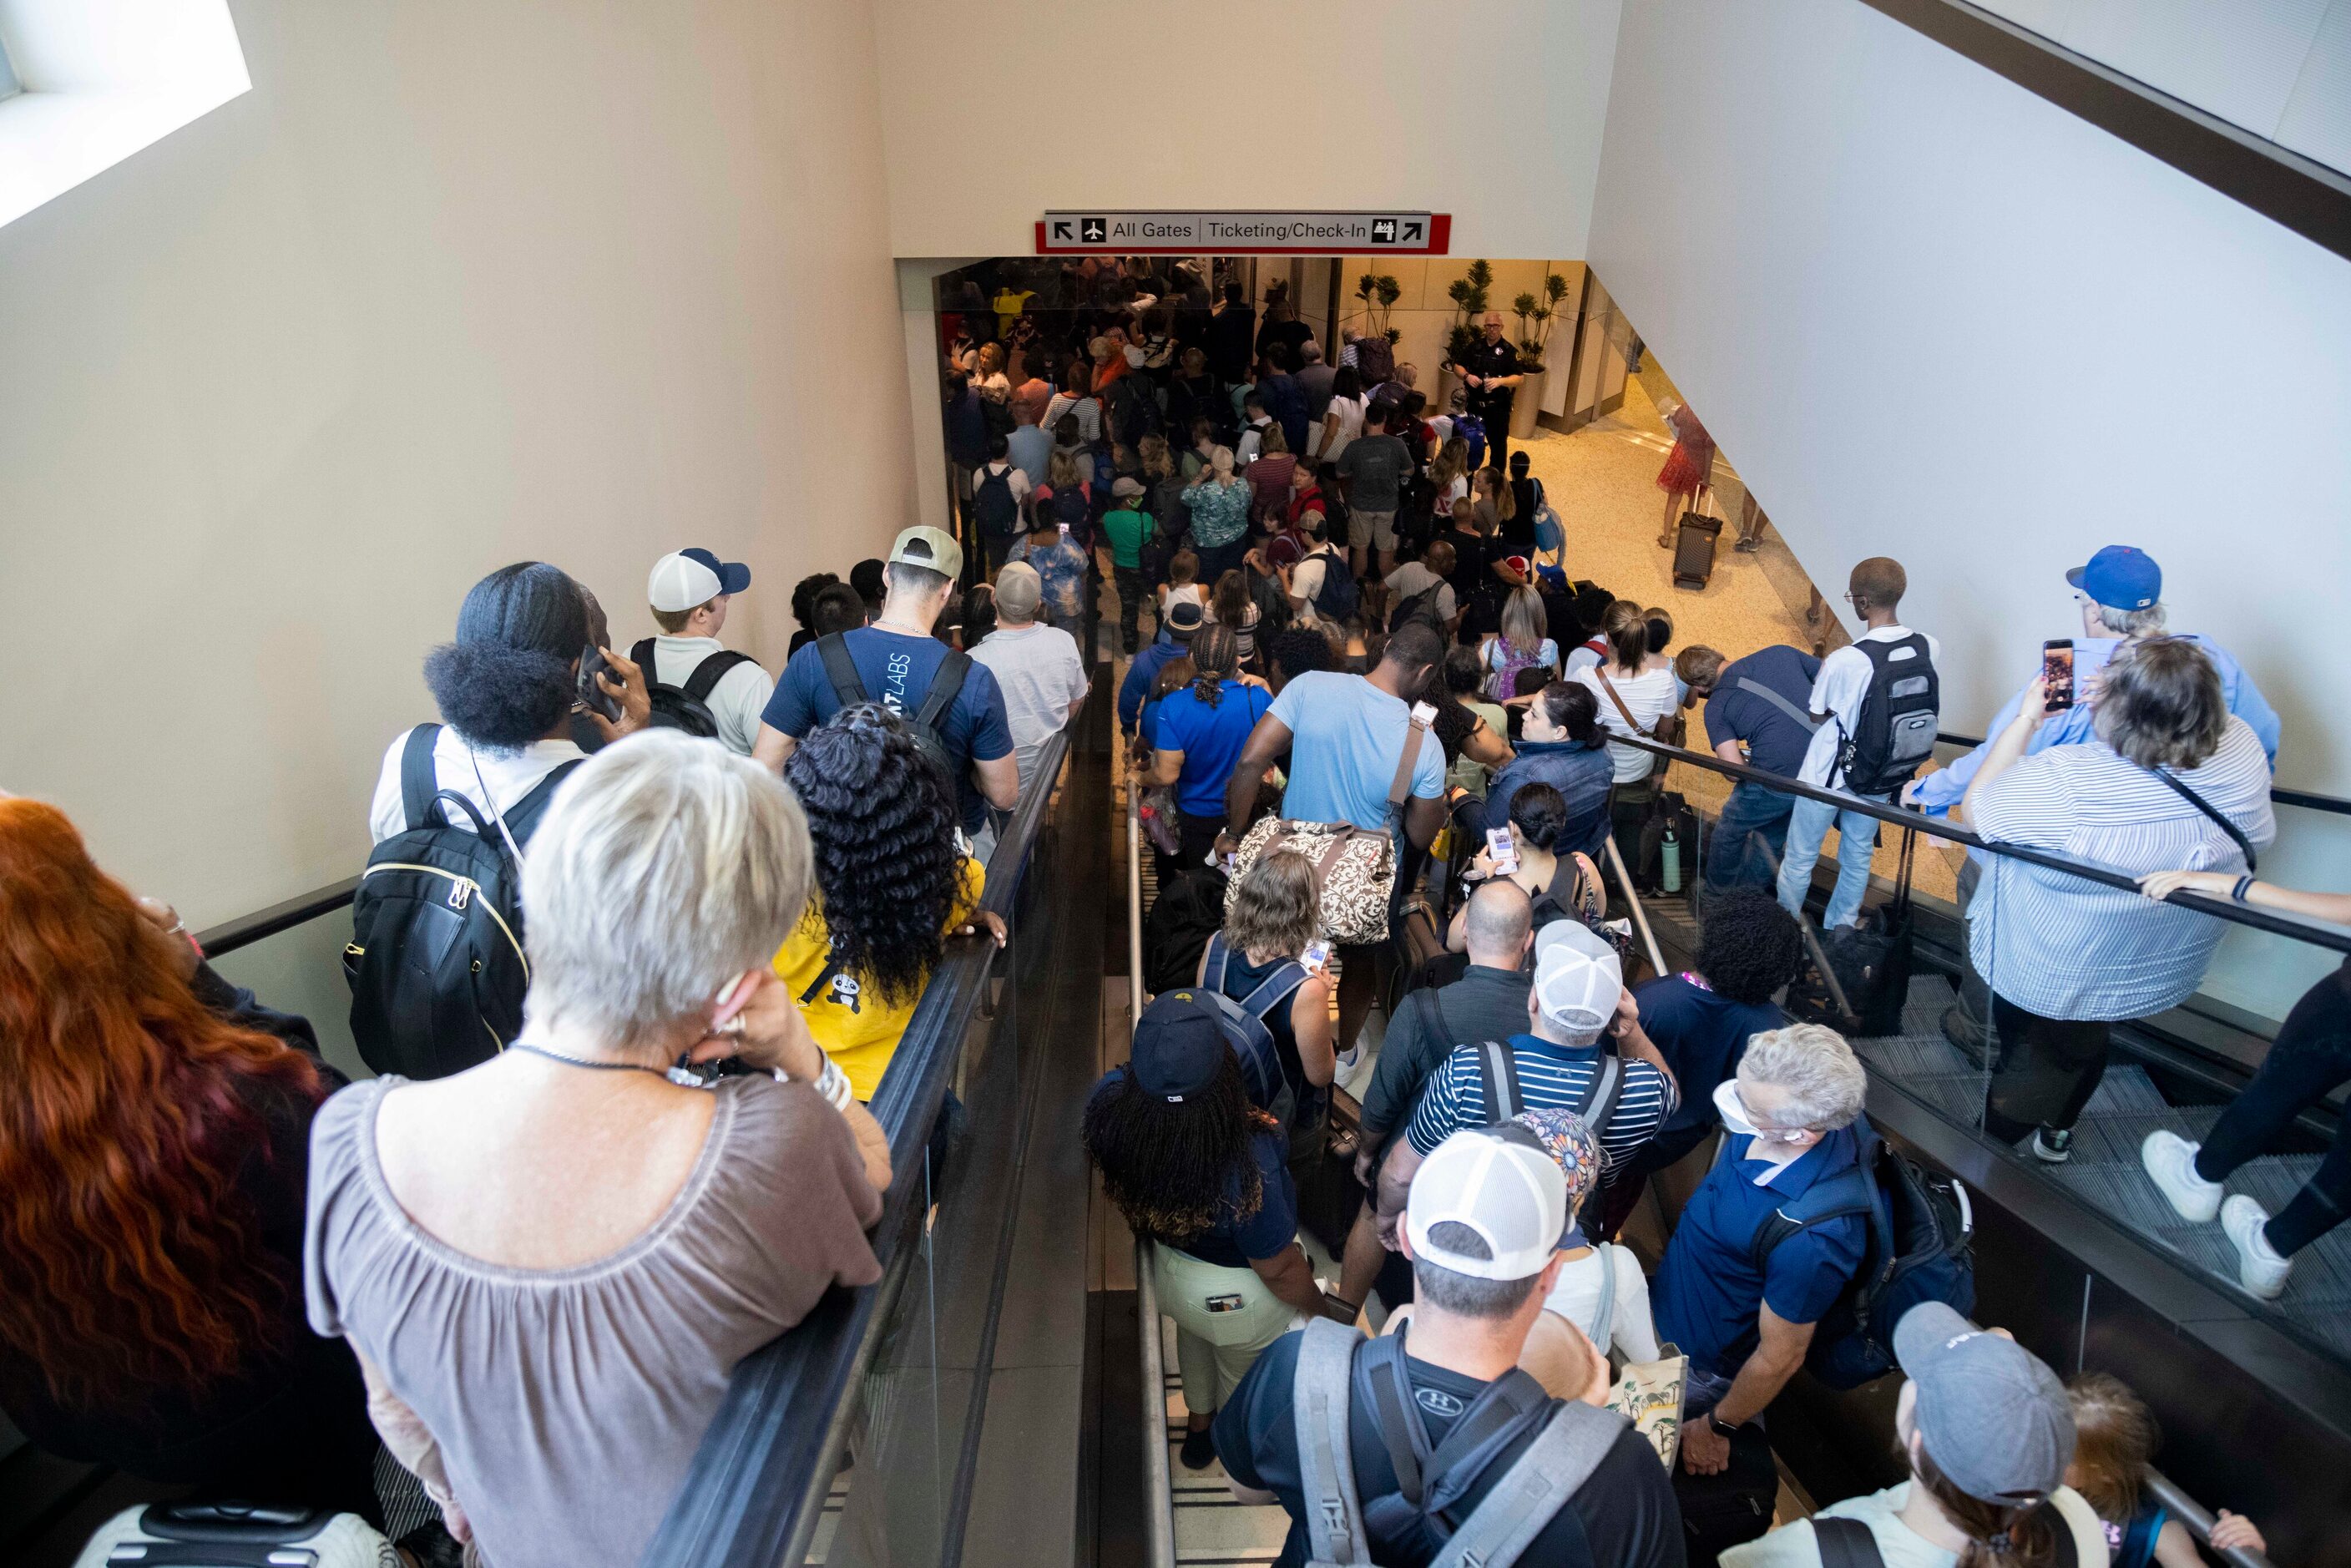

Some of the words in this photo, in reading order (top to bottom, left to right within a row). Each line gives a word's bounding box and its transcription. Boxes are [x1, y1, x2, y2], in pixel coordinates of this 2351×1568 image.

[1113, 222, 1135, 237] All
[1142, 222, 1192, 237] Gates
[1208, 222, 1366, 240] Ticketing/Check-In
